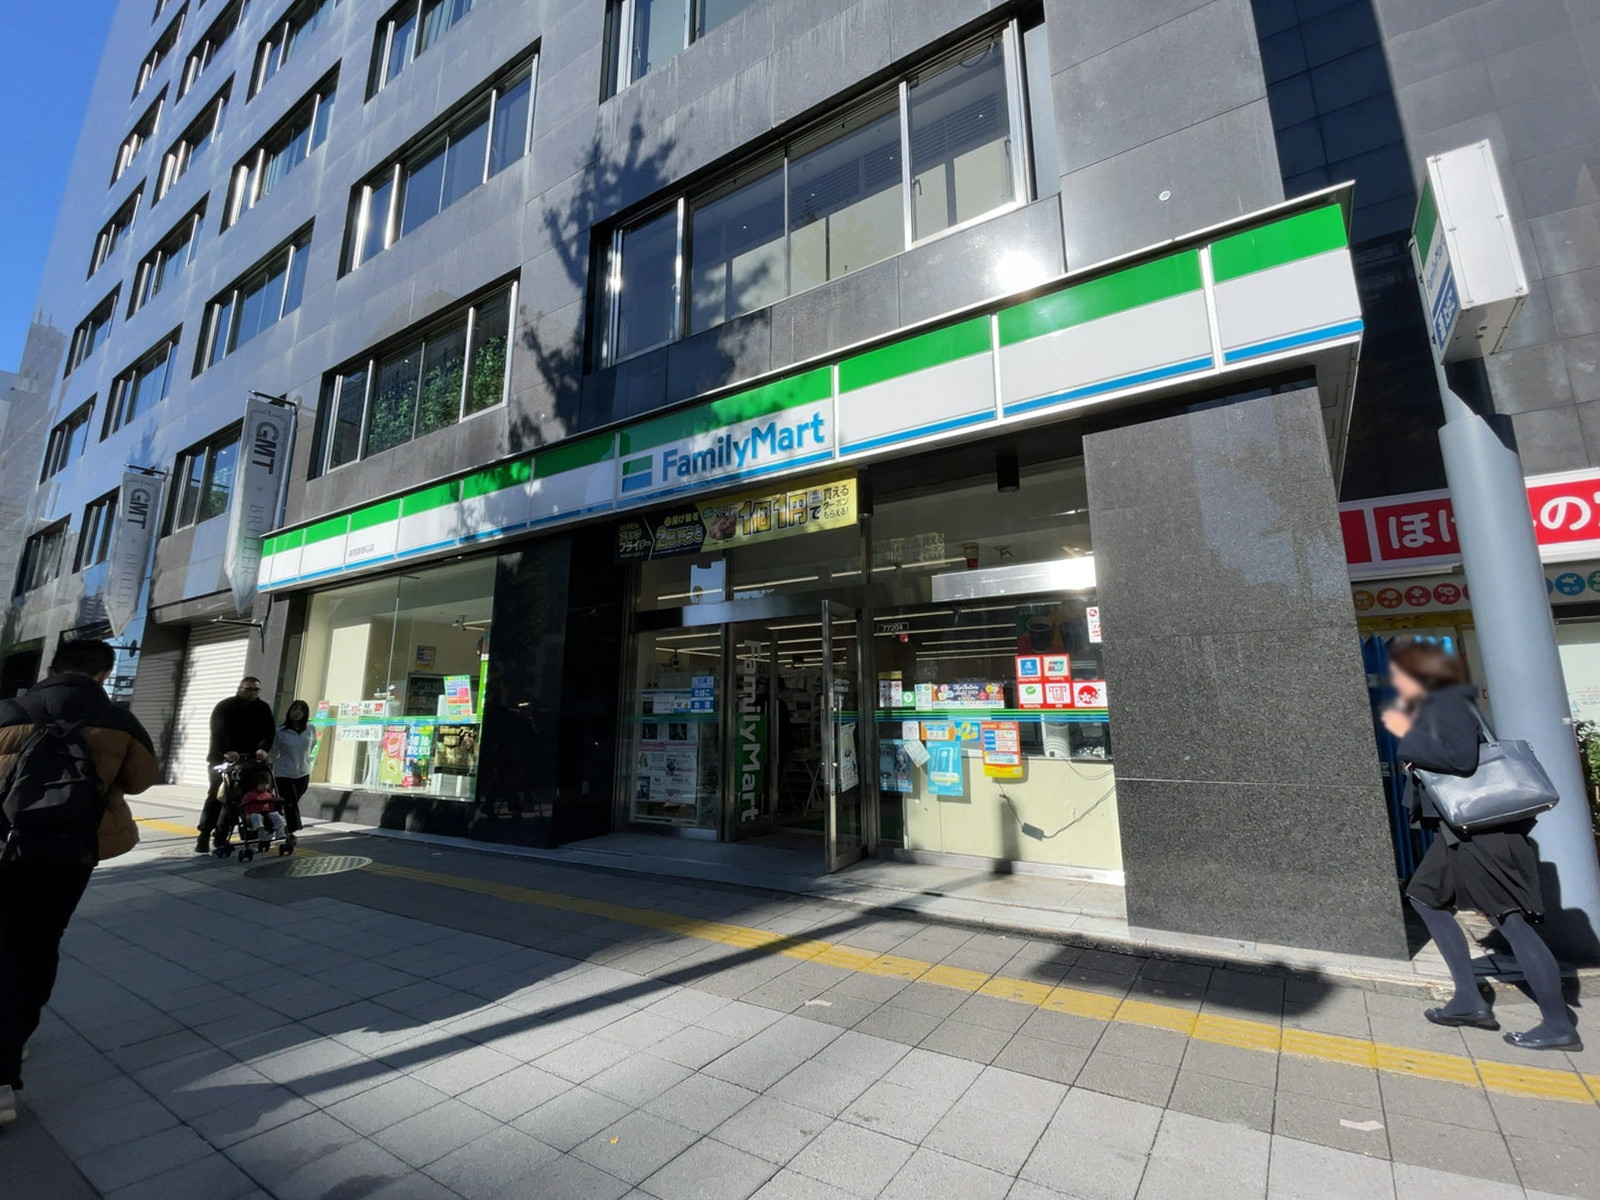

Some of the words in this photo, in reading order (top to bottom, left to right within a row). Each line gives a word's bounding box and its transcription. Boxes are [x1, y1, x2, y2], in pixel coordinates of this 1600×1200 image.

[252, 421, 280, 475] GMT
[662, 411, 826, 482] FamilyMart
[127, 488, 151, 530] GMT
[823, 485, 849, 503] 買える
[740, 639, 762, 824] FamilyMart
